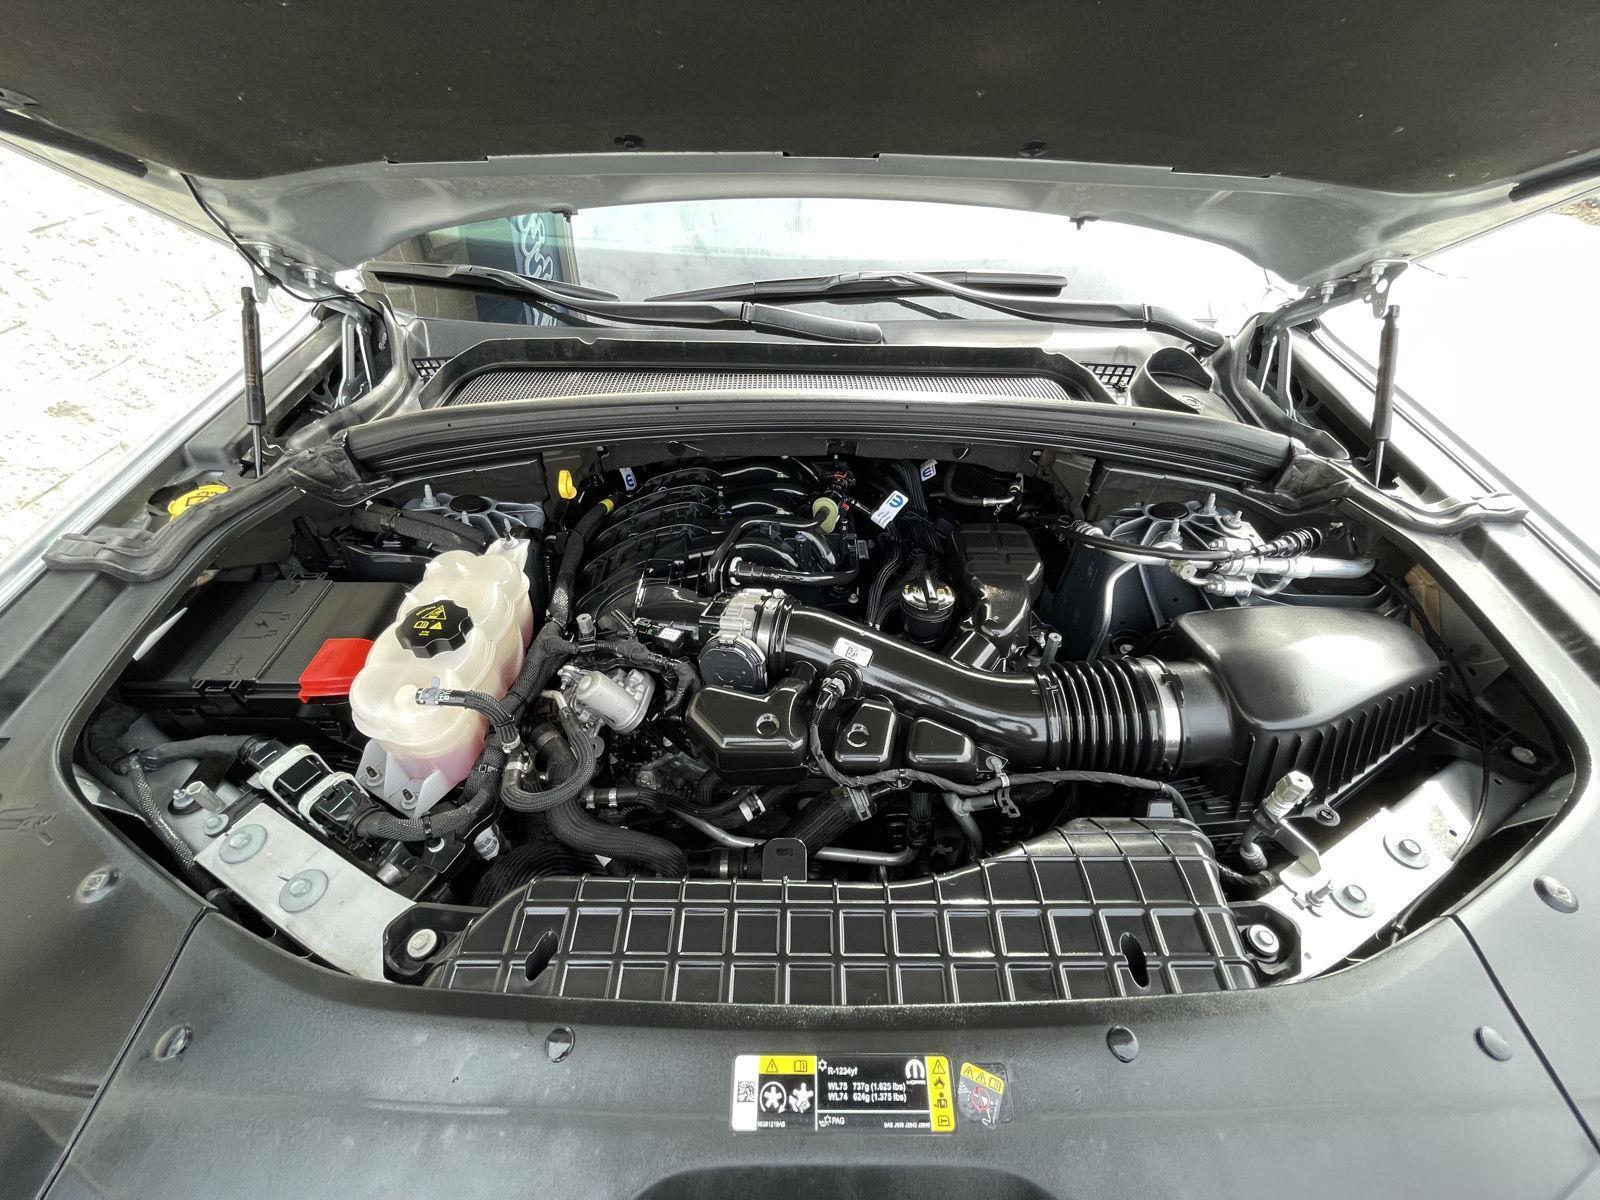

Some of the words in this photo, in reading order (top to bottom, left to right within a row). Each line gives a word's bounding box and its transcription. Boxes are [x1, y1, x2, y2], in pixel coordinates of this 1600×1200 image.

[827, 1066, 858, 1077] R-1234yf
[827, 1082, 848, 1091] WL75
[852, 1082, 870, 1092] 737g
[870, 1082, 891, 1092] (1.625
[892, 1082, 906, 1092] lbs)
[827, 1092, 848, 1101] WL74
[852, 1092, 870, 1103] 624g
[871, 1092, 892, 1103] (1.375
[893, 1092, 907, 1103] lbs)
